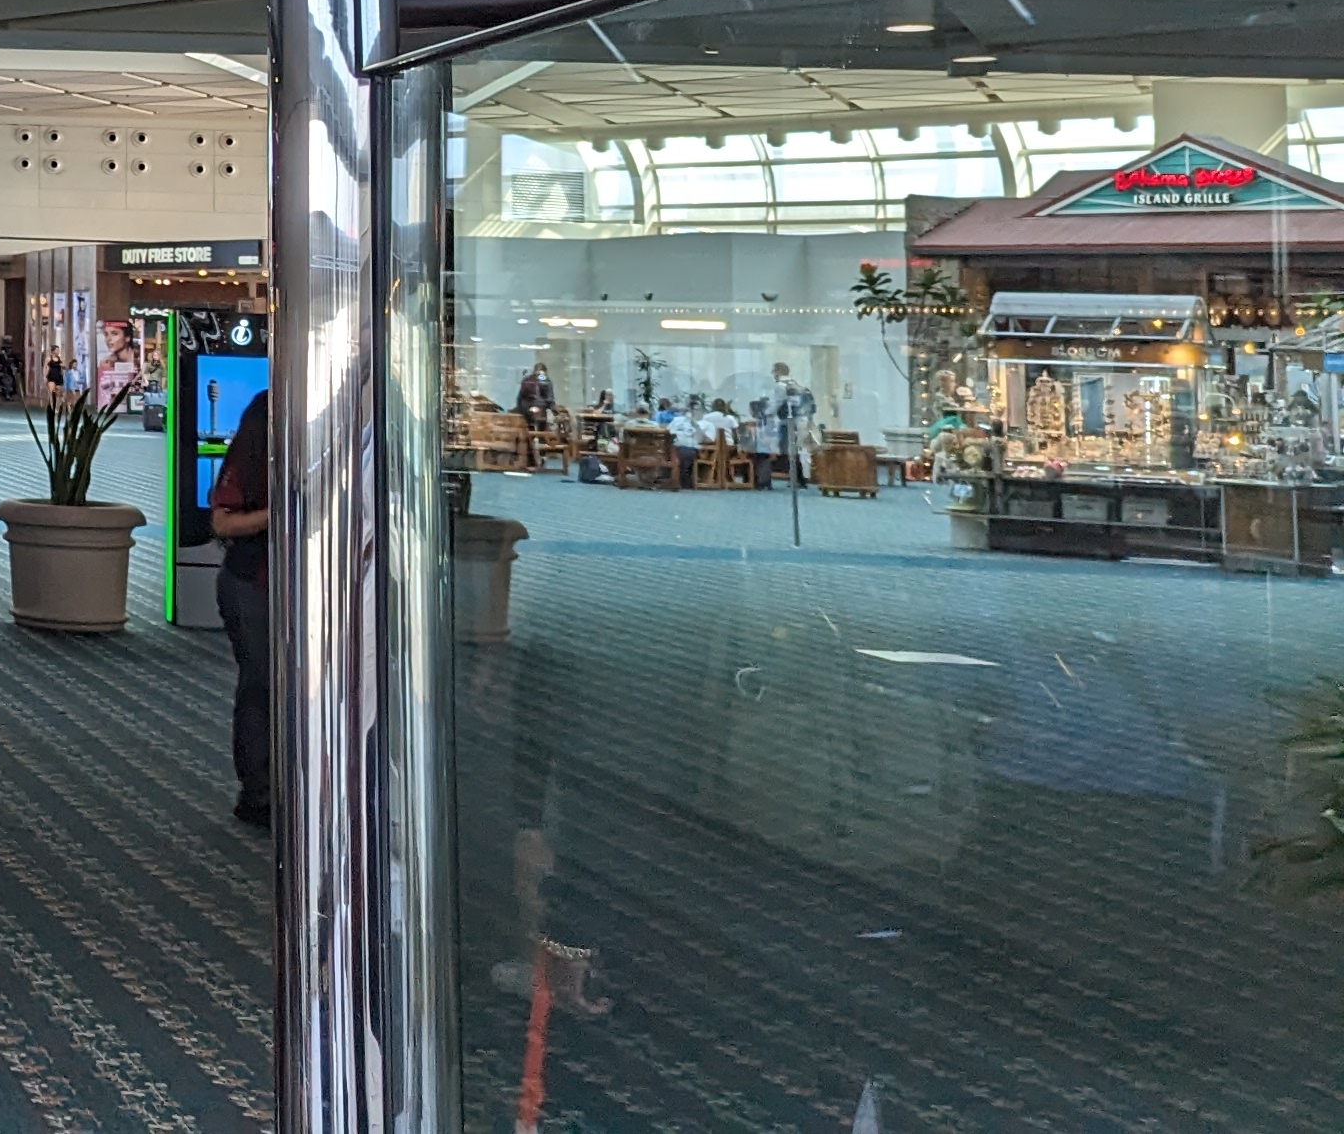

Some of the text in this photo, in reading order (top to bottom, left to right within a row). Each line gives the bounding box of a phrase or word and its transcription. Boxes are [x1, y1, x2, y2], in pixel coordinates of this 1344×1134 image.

[1133, 192, 1230, 205] ISLAND GRILLE
[121, 246, 212, 265] DUTY FREE STORE
